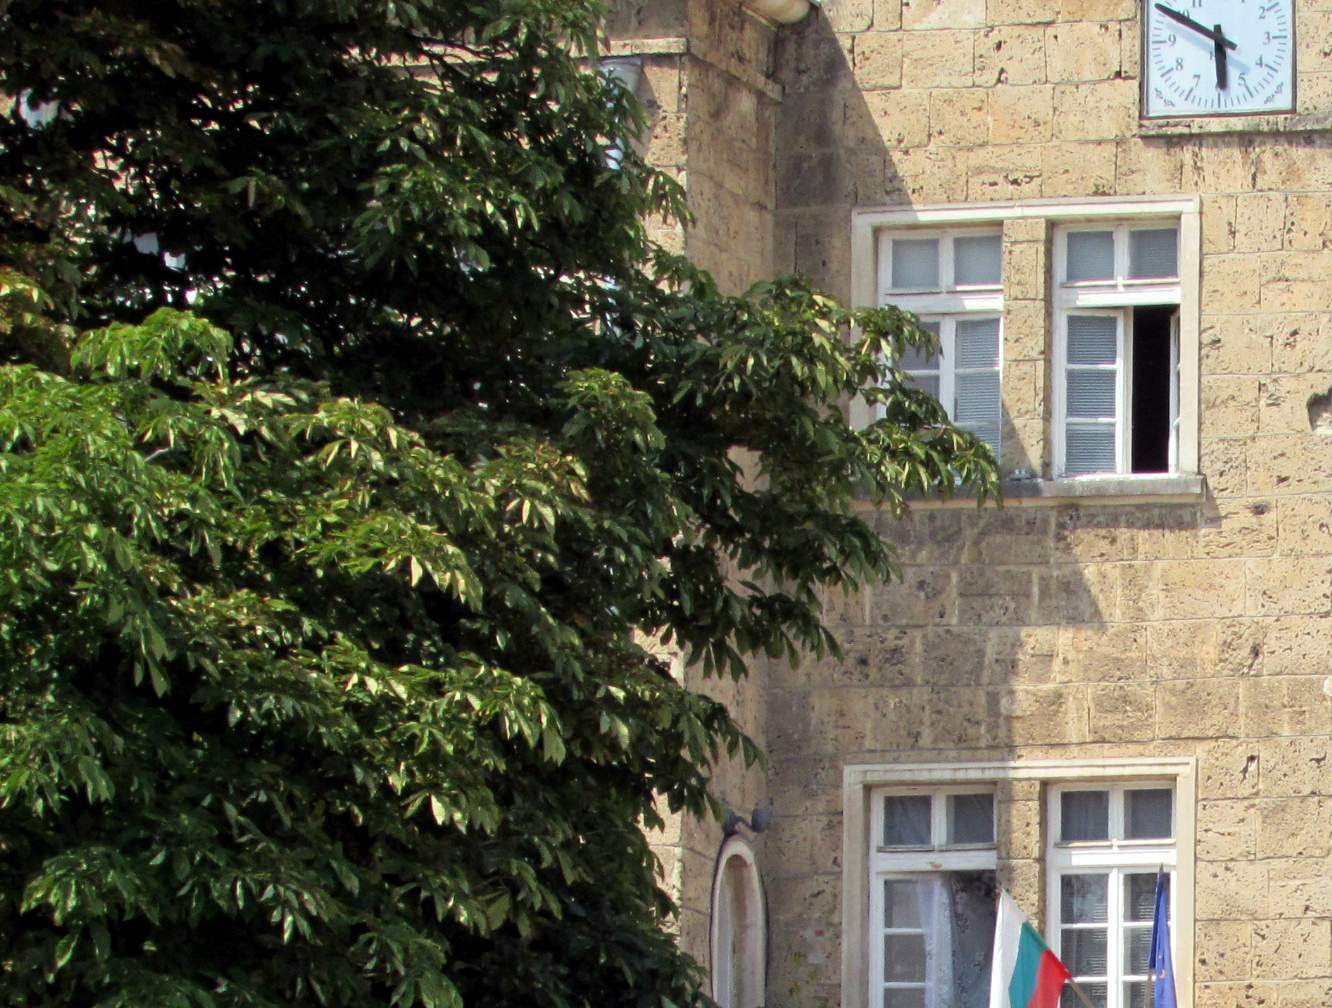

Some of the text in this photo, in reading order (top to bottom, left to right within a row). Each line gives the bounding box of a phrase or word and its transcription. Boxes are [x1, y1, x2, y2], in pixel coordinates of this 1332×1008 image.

[1259, 7, 1266, 19] 2
[1168, 34, 1176, 47] 9
[1263, 32, 1271, 45] 3
[1175, 58, 1183, 71] 8
[1256, 55, 1264, 68] 4
[1193, 75, 1200, 88] 7
[1238, 73, 1246, 86] 5
